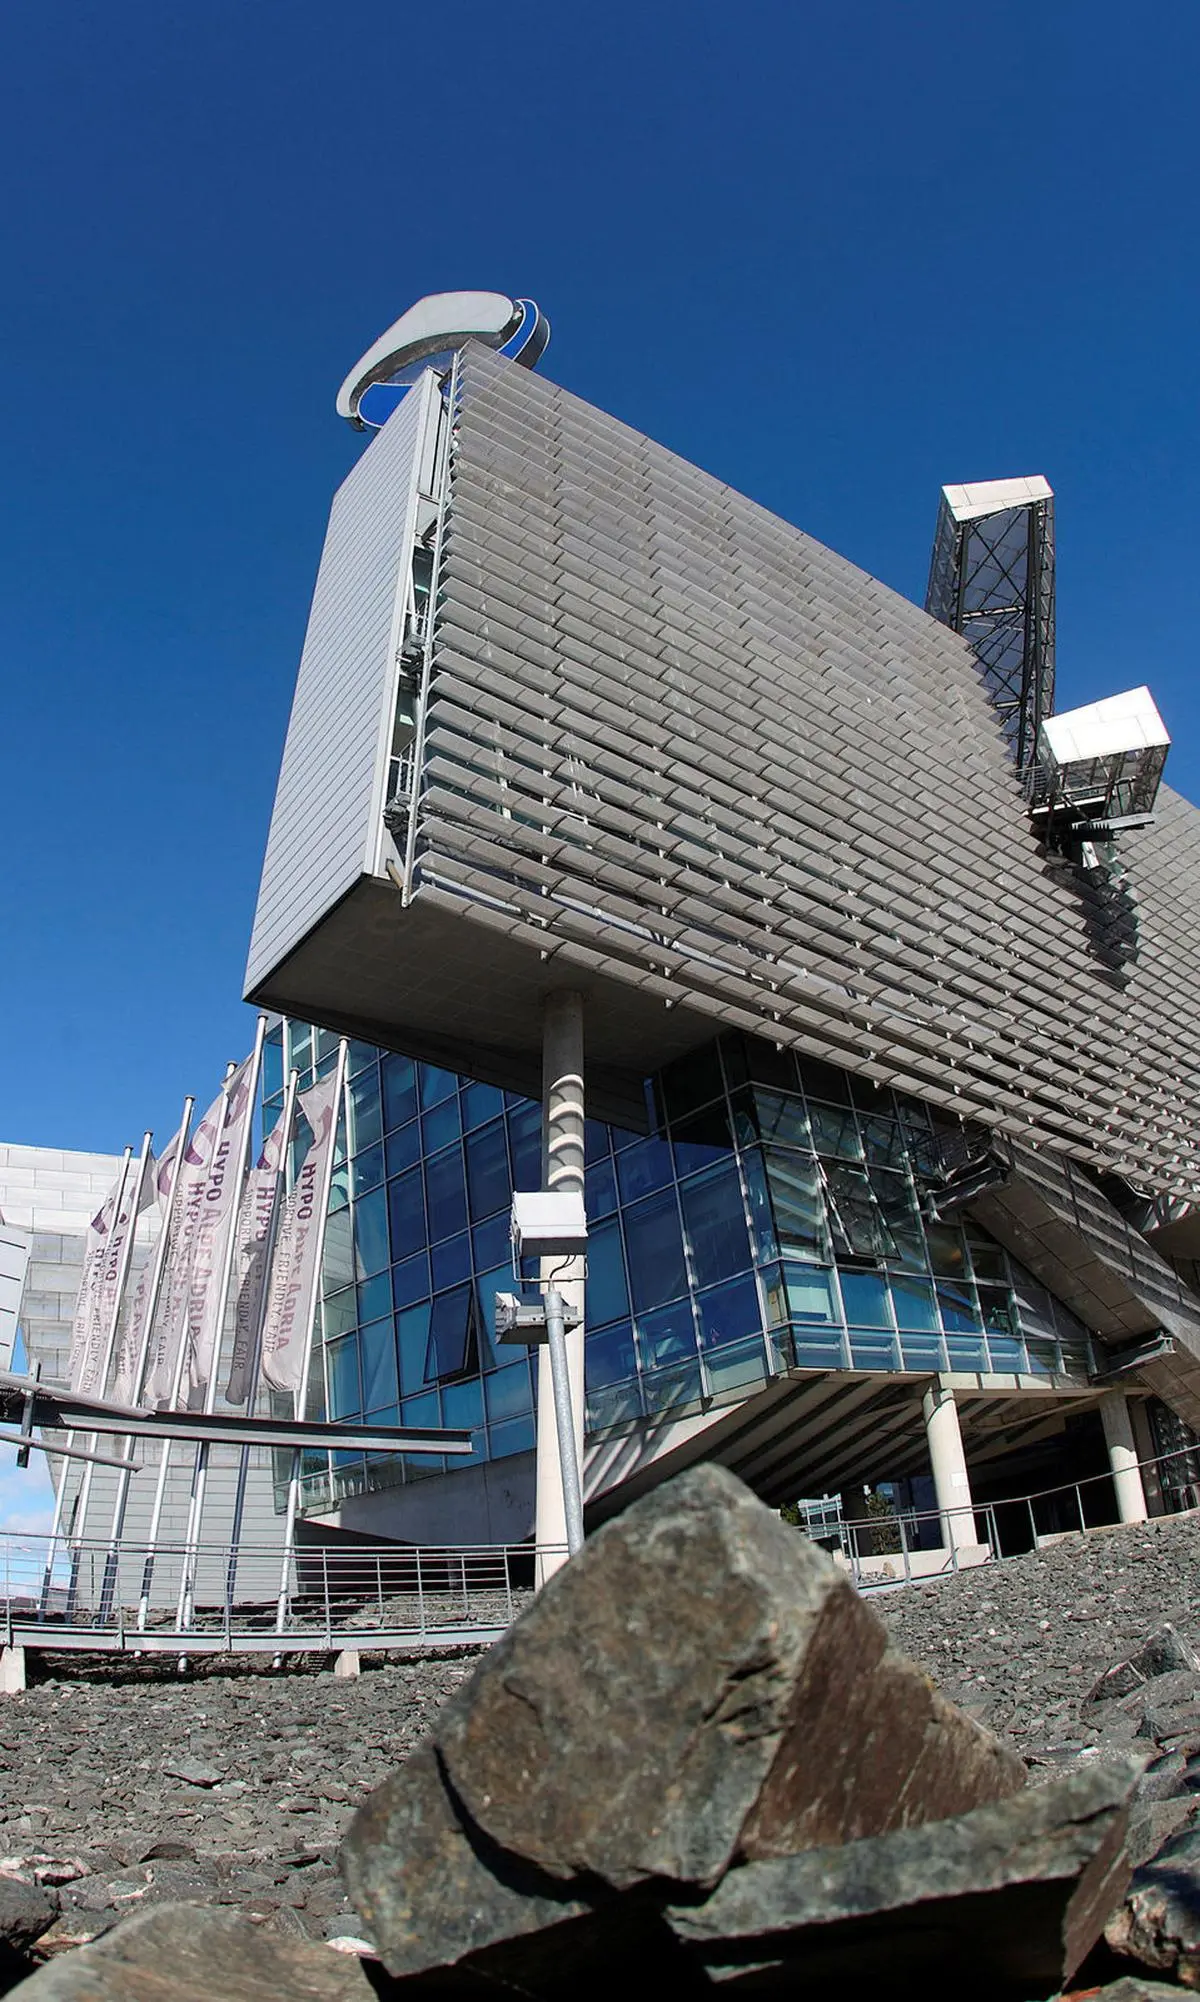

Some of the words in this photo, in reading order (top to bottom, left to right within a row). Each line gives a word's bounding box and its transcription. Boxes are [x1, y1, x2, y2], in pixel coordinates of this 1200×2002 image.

[206, 1141, 231, 1202] HYPO
[297, 1161, 317, 1221] HYPO
[255, 1187, 275, 1242] HYPO
[275, 1283, 303, 1351] ADRIA
